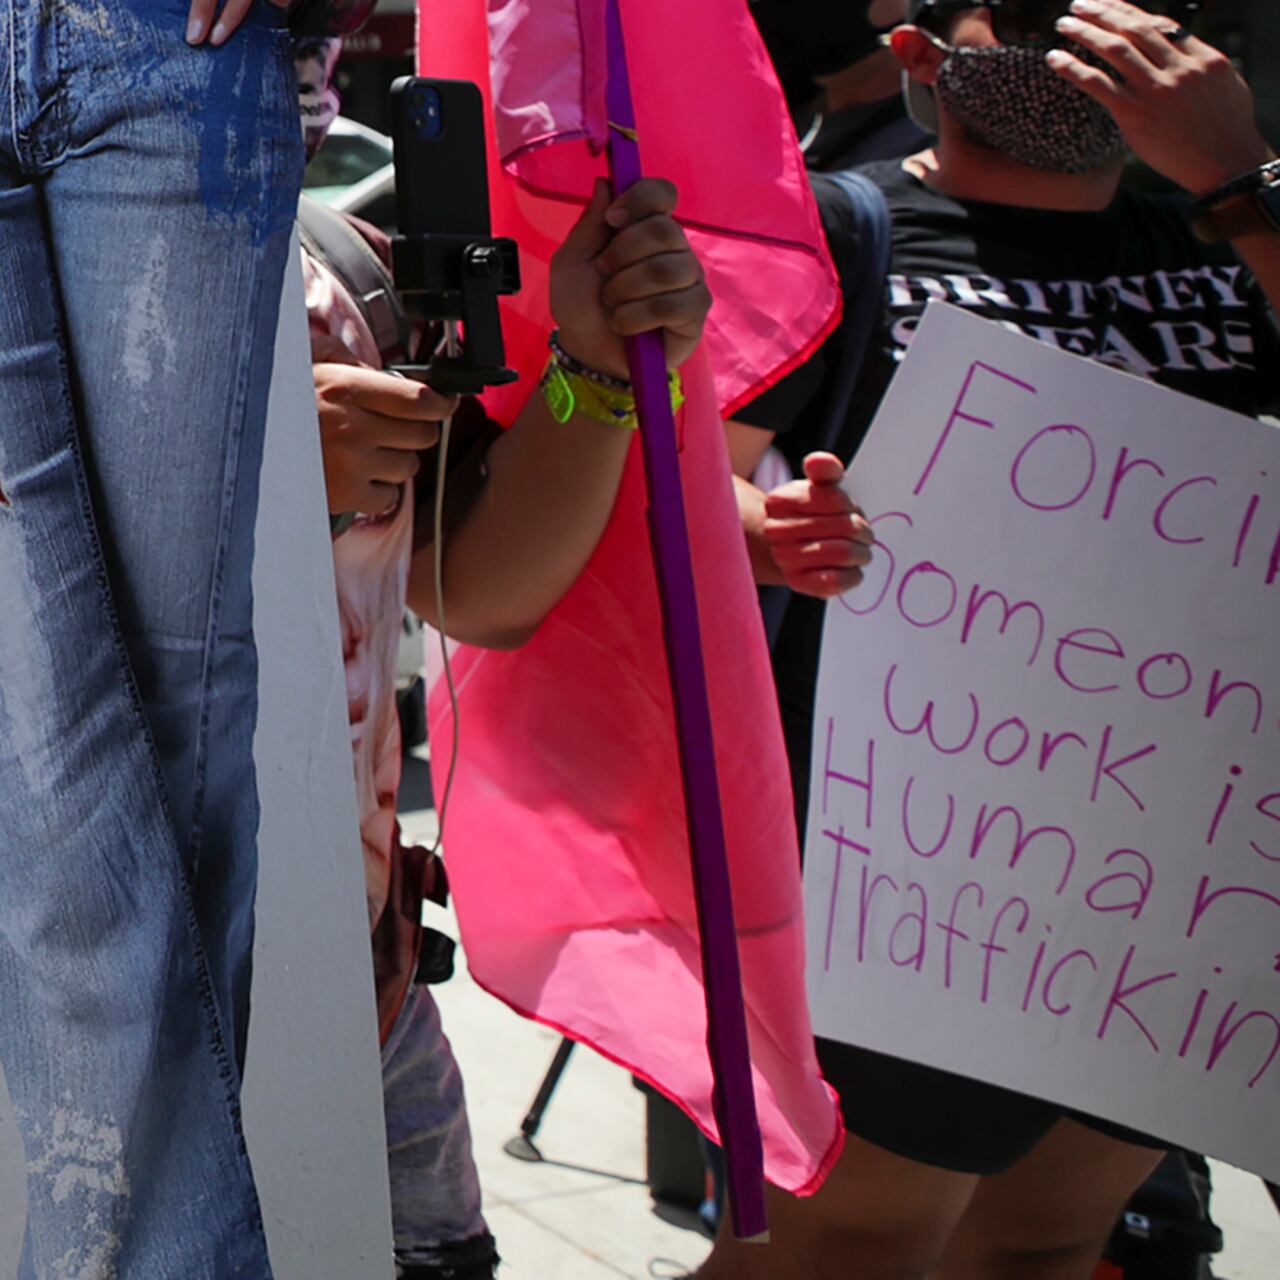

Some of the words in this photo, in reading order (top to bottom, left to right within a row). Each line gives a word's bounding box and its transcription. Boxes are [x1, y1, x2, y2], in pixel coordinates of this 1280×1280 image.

[890, 317, 1256, 382] SEARS
[837, 510, 1270, 736] Someon
[884, 663, 1158, 813] work
